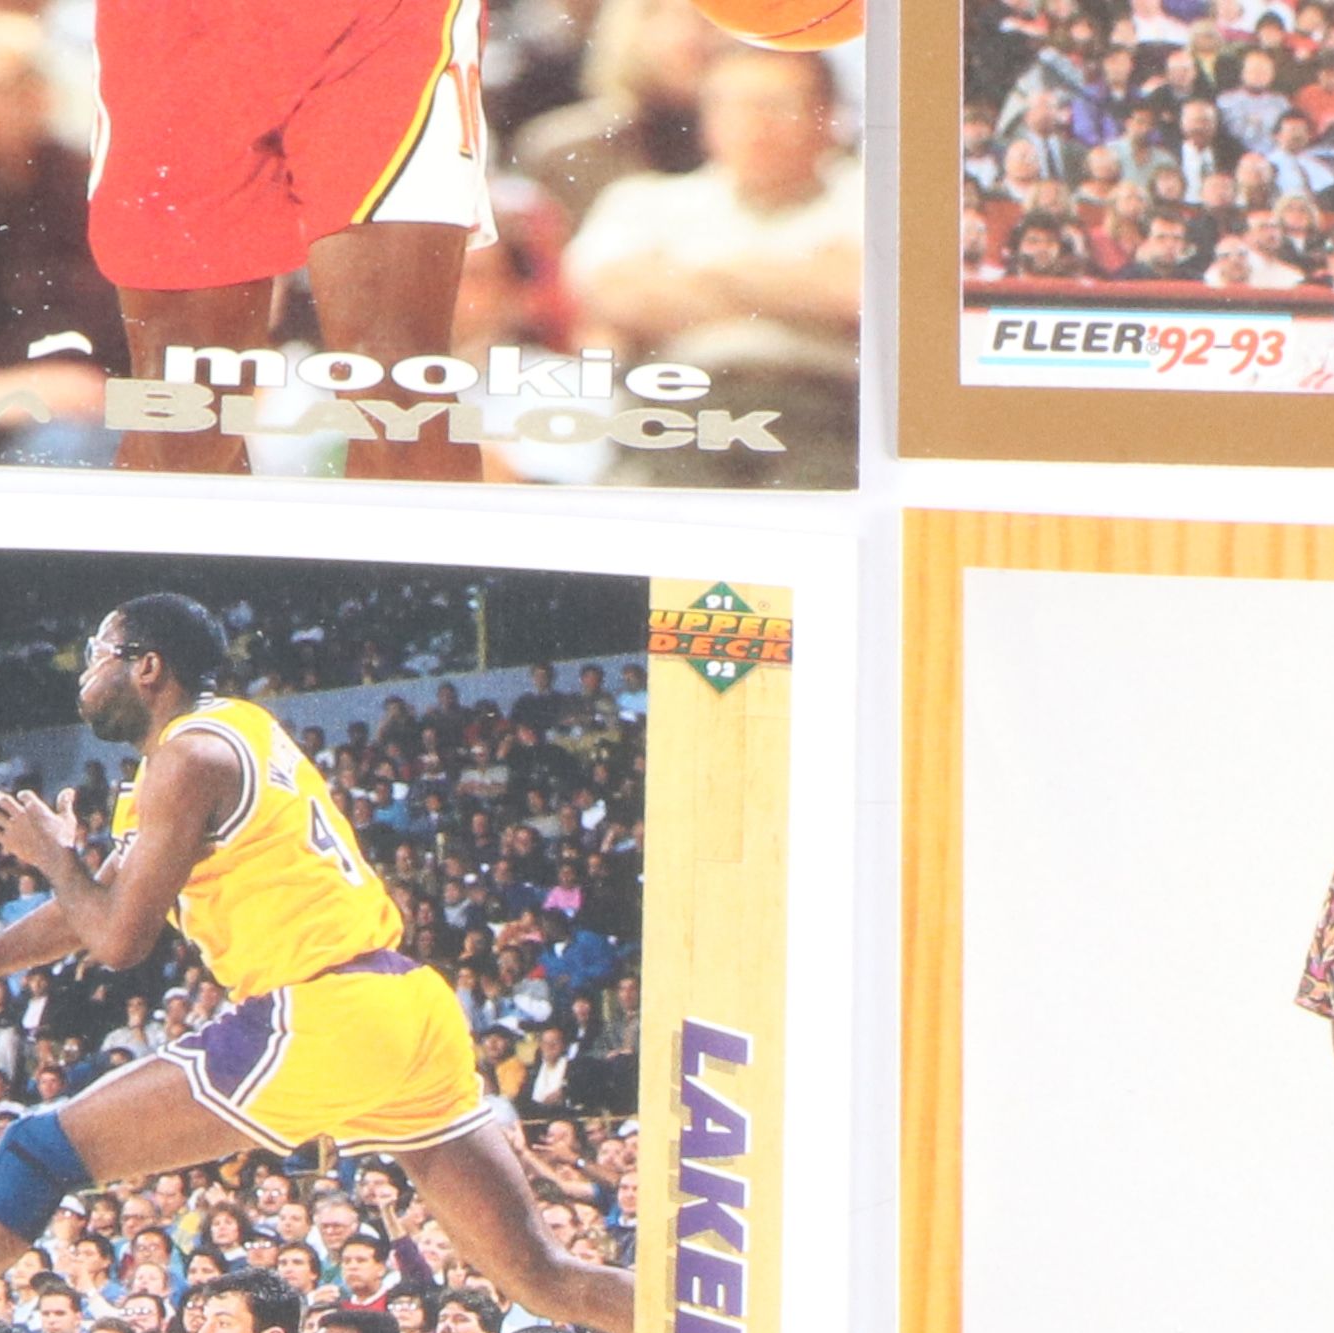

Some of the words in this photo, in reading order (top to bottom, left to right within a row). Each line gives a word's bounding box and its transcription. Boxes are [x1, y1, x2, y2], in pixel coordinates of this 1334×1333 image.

[991, 319, 1146, 354] FLEER
[164, 345, 713, 401] mookie
[704, 593, 734, 611] 91
[648, 609, 793, 640] UPPER
[705, 660, 737, 678] 92
